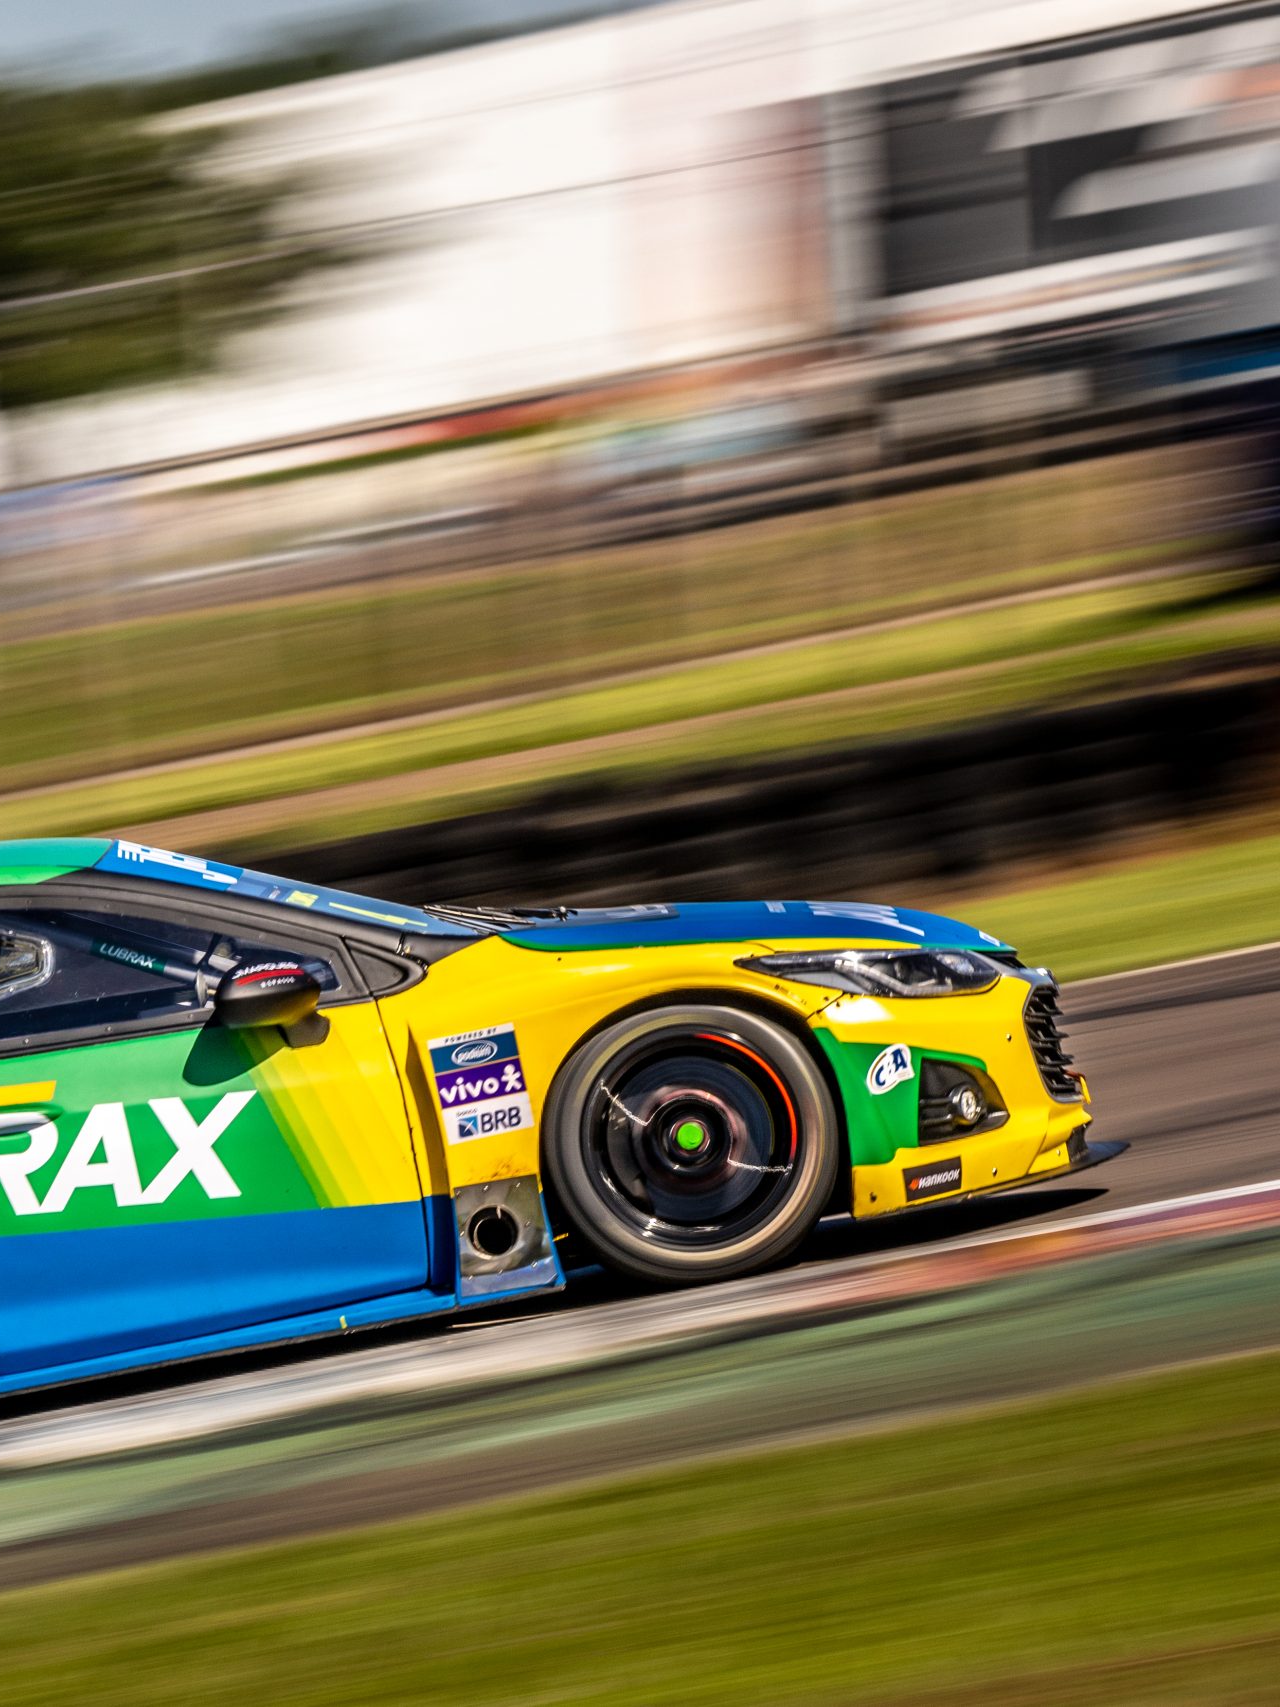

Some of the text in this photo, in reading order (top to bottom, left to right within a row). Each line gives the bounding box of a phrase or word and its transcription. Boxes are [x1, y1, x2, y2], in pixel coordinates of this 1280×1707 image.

[99, 943, 157, 969] LUBRAX
[439, 1076, 500, 1104] vivo
[481, 1106, 522, 1134] BRB
